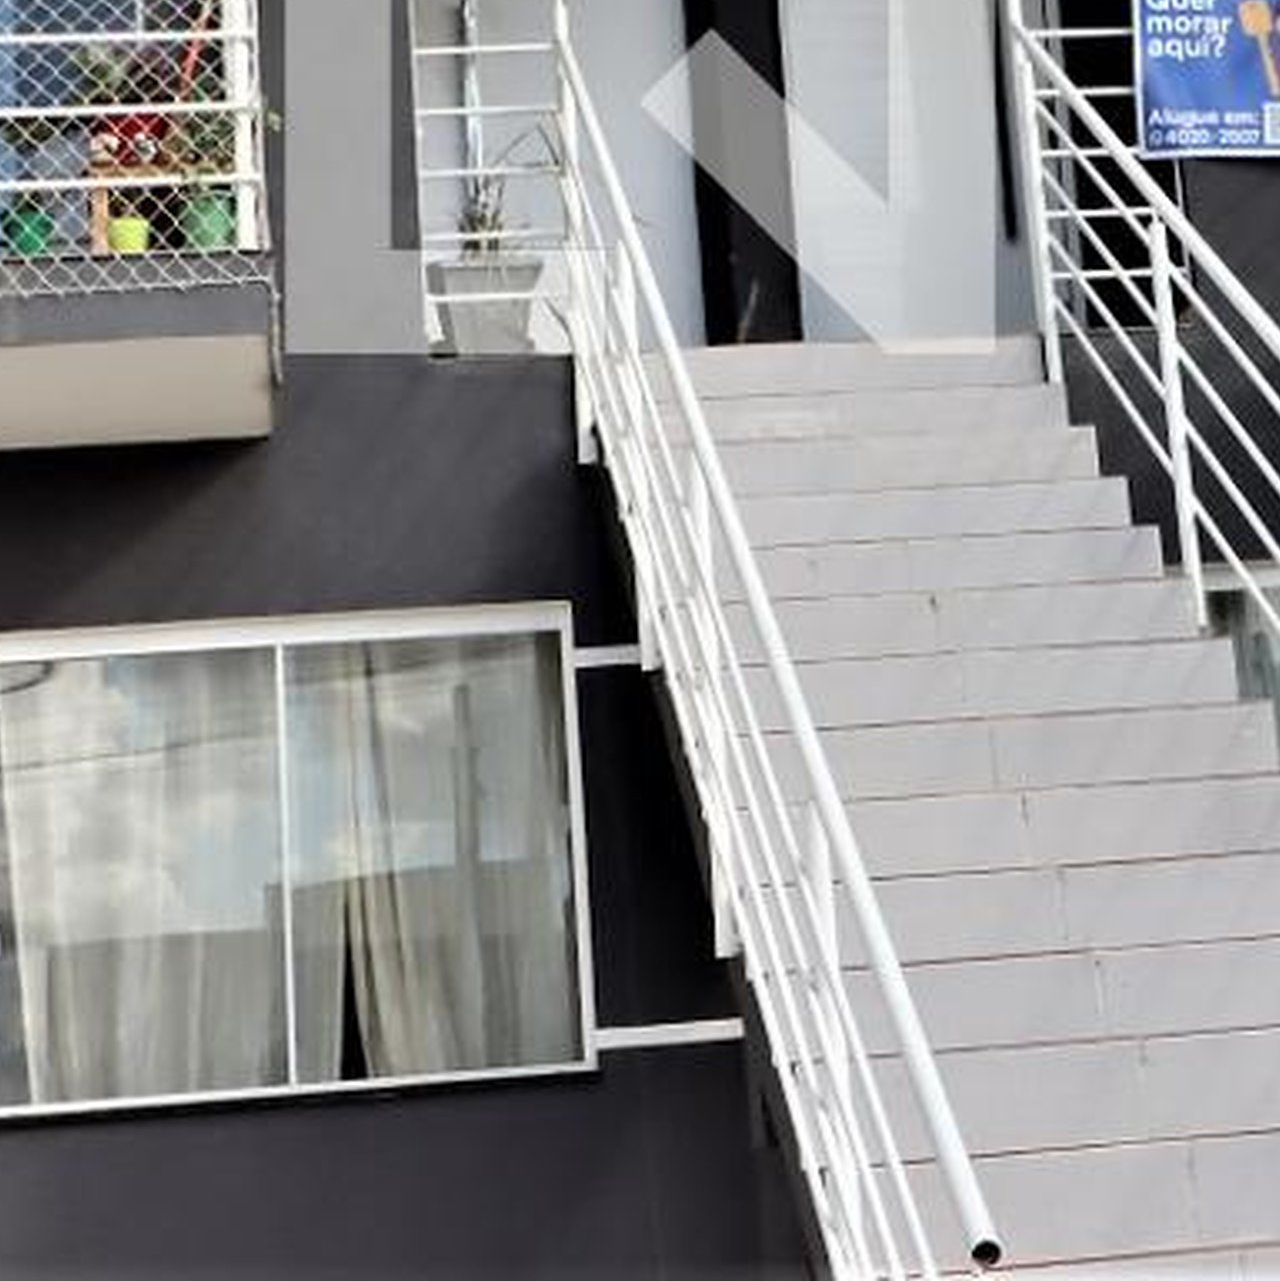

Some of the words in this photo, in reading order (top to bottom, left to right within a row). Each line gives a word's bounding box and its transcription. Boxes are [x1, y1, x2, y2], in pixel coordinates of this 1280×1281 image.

[1147, 16, 1233, 34] morar
[1148, 34, 1226, 61] aqui?
[1148, 107, 1219, 128] Alugue
